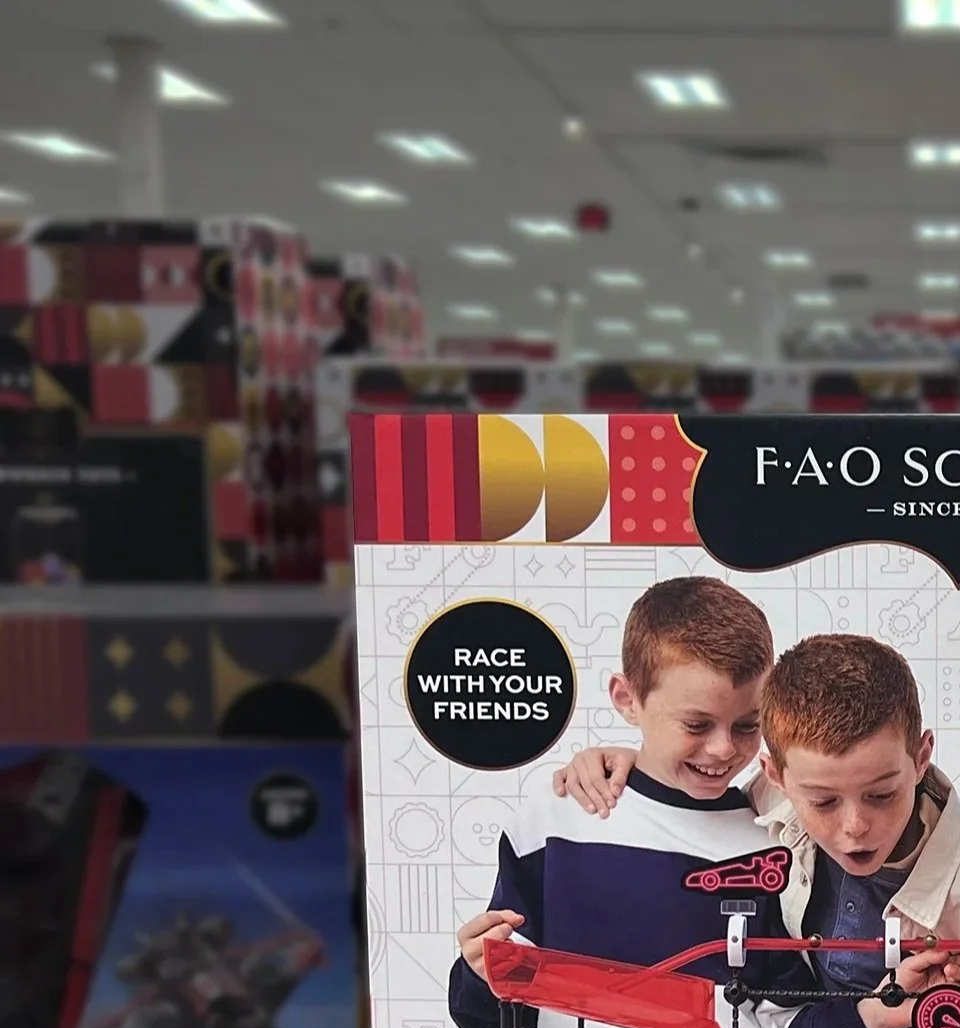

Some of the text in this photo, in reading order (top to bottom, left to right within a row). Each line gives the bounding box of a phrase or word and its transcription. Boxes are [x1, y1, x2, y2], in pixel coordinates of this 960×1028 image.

[454, 648, 526, 667] RACE
[417, 675, 562, 694] WITH YOUR
[434, 701, 549, 721] FRIENDS
